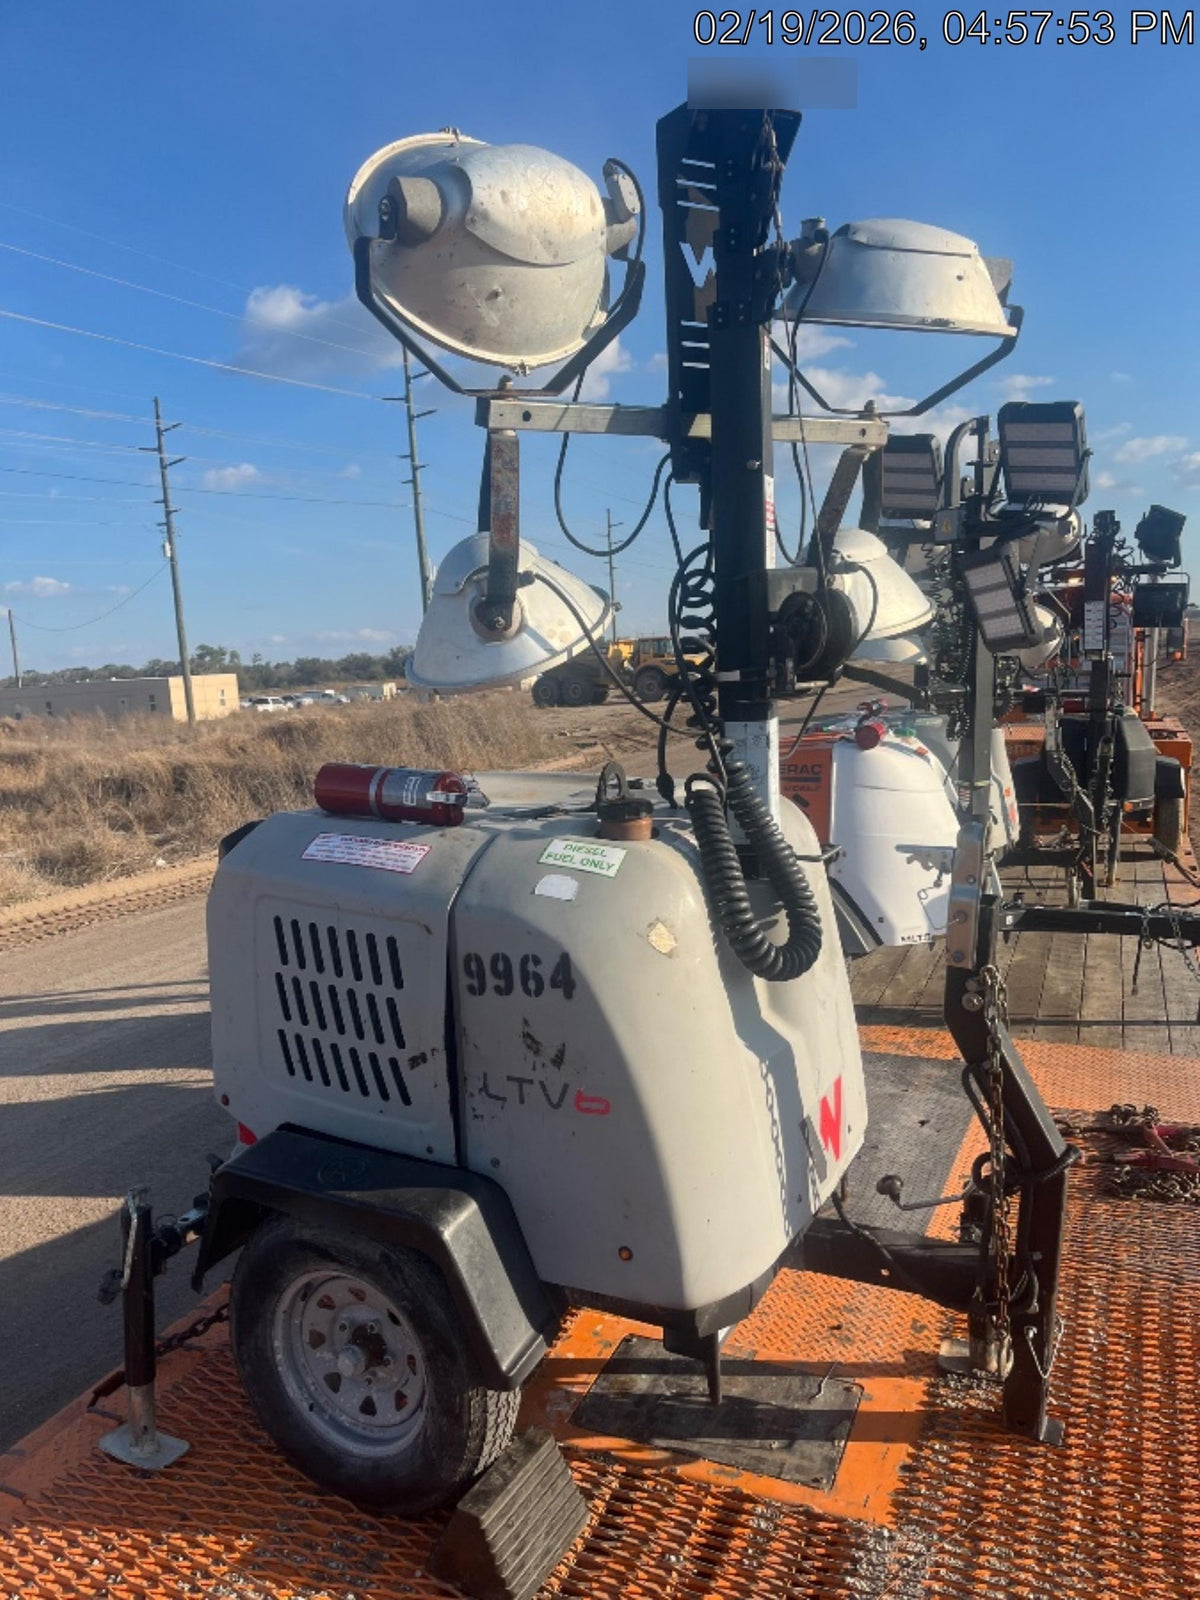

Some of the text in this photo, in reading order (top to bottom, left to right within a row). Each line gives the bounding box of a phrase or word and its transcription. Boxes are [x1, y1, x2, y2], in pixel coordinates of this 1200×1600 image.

[779, 763, 822, 775] ERAC
[563, 843, 608, 858] DIESEL
[545, 851, 616, 872] FUEL ONLY
[463, 952, 577, 1000] 9964
